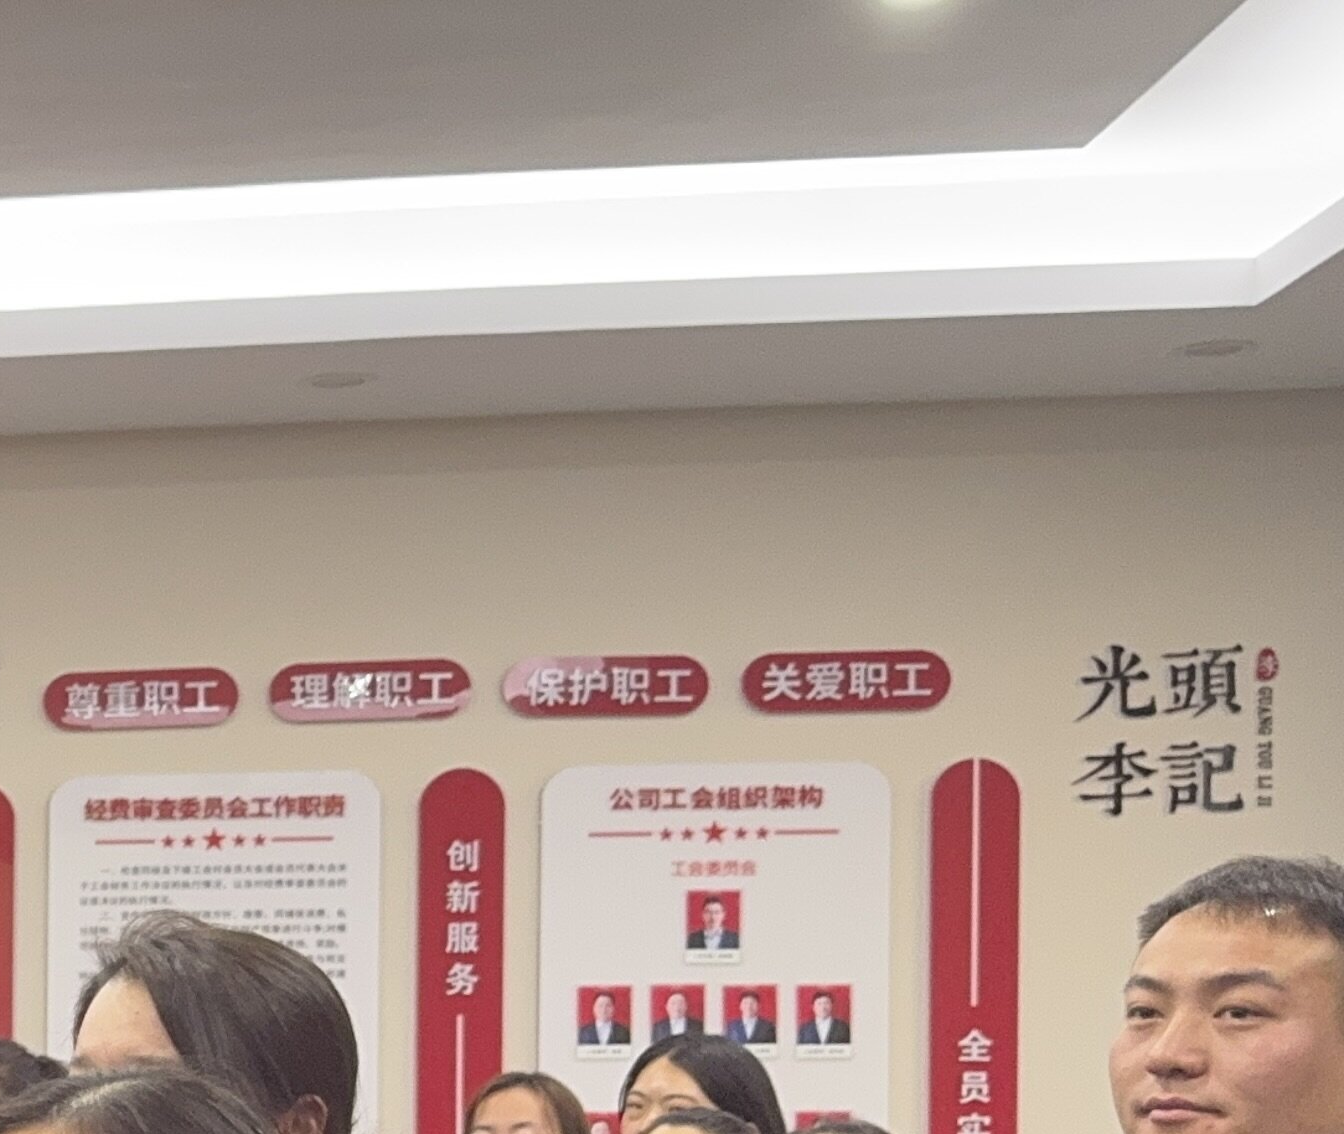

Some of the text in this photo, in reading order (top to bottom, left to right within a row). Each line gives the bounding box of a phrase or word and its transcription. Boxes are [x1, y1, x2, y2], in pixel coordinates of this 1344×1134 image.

[64, 680, 220, 720] 尊重职工
[289, 670, 456, 711] 理解职工
[525, 666, 693, 706] 保护职工
[761, 660, 933, 702] 关爱职工
[1073, 644, 1244, 723] 光頭
[610, 785, 824, 811] 公司工会组织架构
[1070, 741, 1244, 816] 李記
[84, 794, 345, 821] 经费审查委员会工作职责
[445, 840, 480, 996] 创新服务
